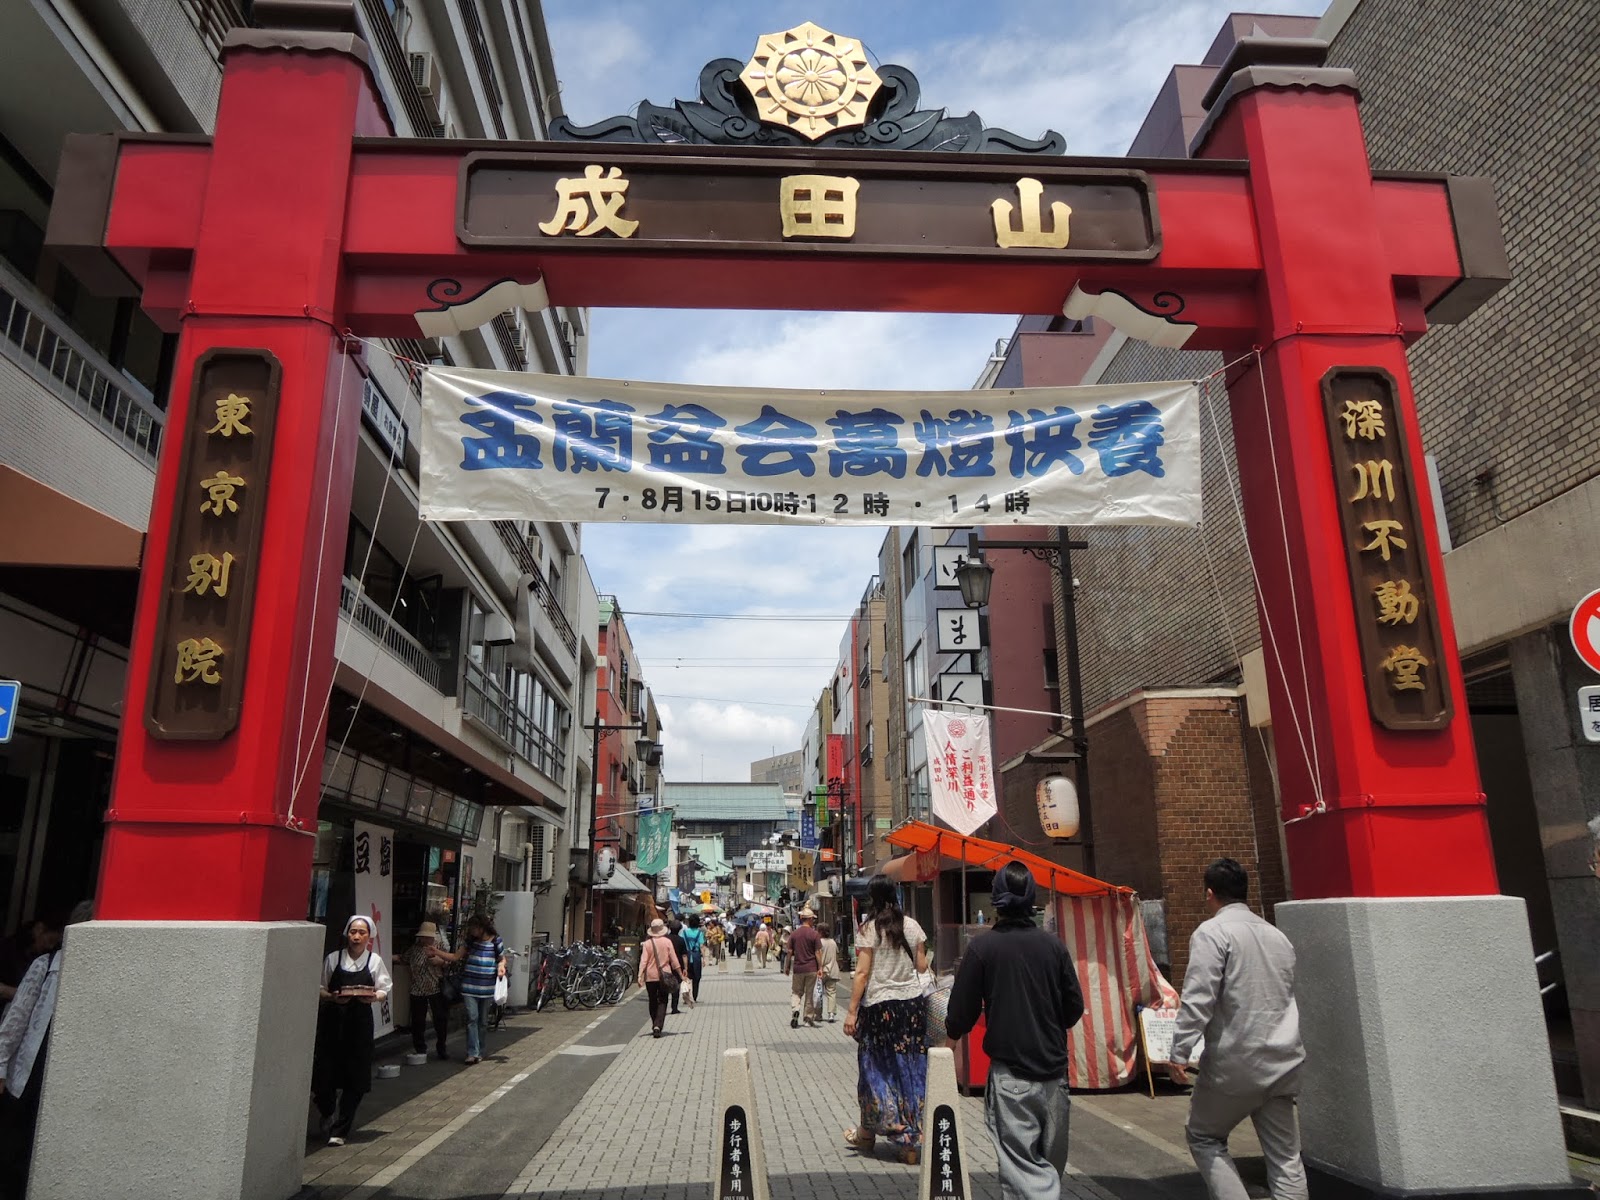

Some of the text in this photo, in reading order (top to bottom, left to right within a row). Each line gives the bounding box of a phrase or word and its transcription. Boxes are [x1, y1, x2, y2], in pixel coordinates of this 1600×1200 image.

[538, 164, 1072, 249] 成田山
[173, 392, 255, 685] 東京別院
[1341, 399, 1430, 691] 深川不動堂
[934, 757, 942, 783] 成田山
[944, 740, 959, 793] 人情深川
[961, 747, 976, 812] ご利益通り
[977, 755, 989, 799] 深川不動堂
[355, 831, 370, 875] 豆
[729, 1118, 743, 1193] 歩行者専用
[938, 1118, 953, 1193] 歩行者専用
